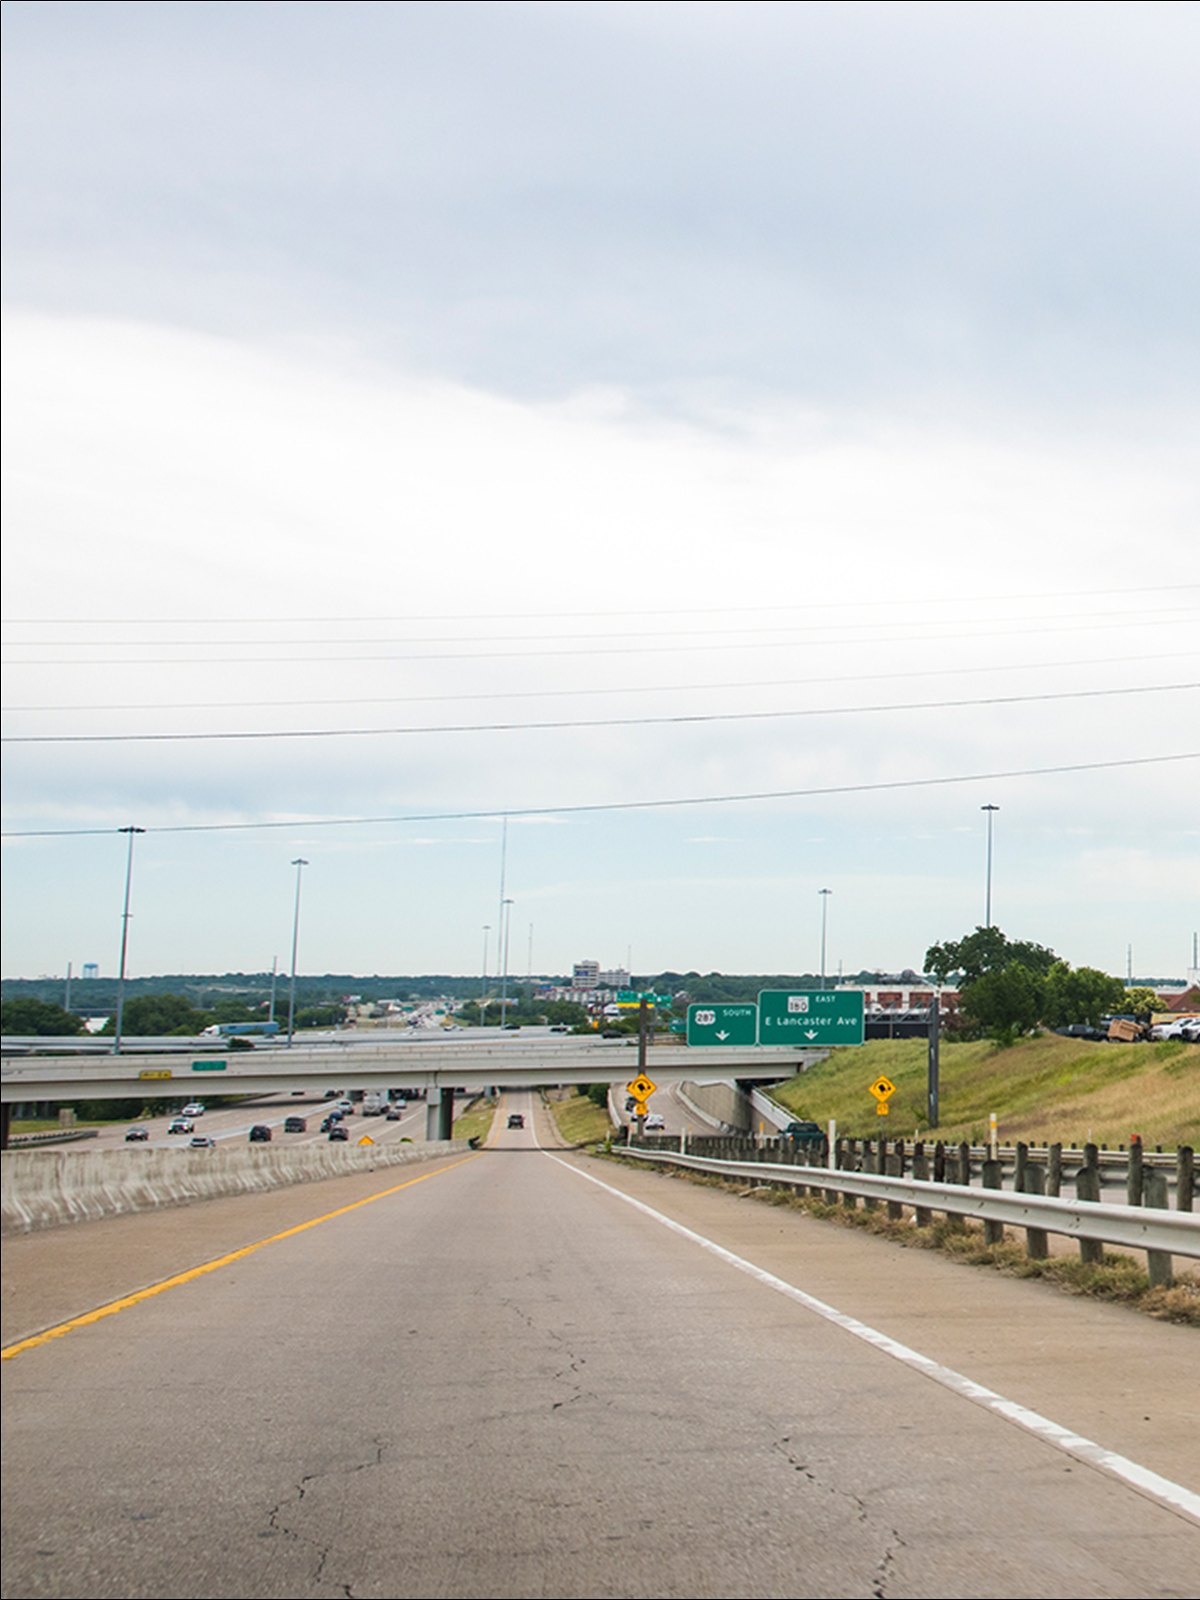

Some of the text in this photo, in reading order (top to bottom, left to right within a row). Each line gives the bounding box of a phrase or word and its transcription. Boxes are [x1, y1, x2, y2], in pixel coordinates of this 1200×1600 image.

[815, 995, 836, 1003] EAST
[696, 1012, 714, 1022] 287
[722, 1009, 752, 1017] SOUTH
[765, 1016, 858, 1026] E Lancaster Ave
